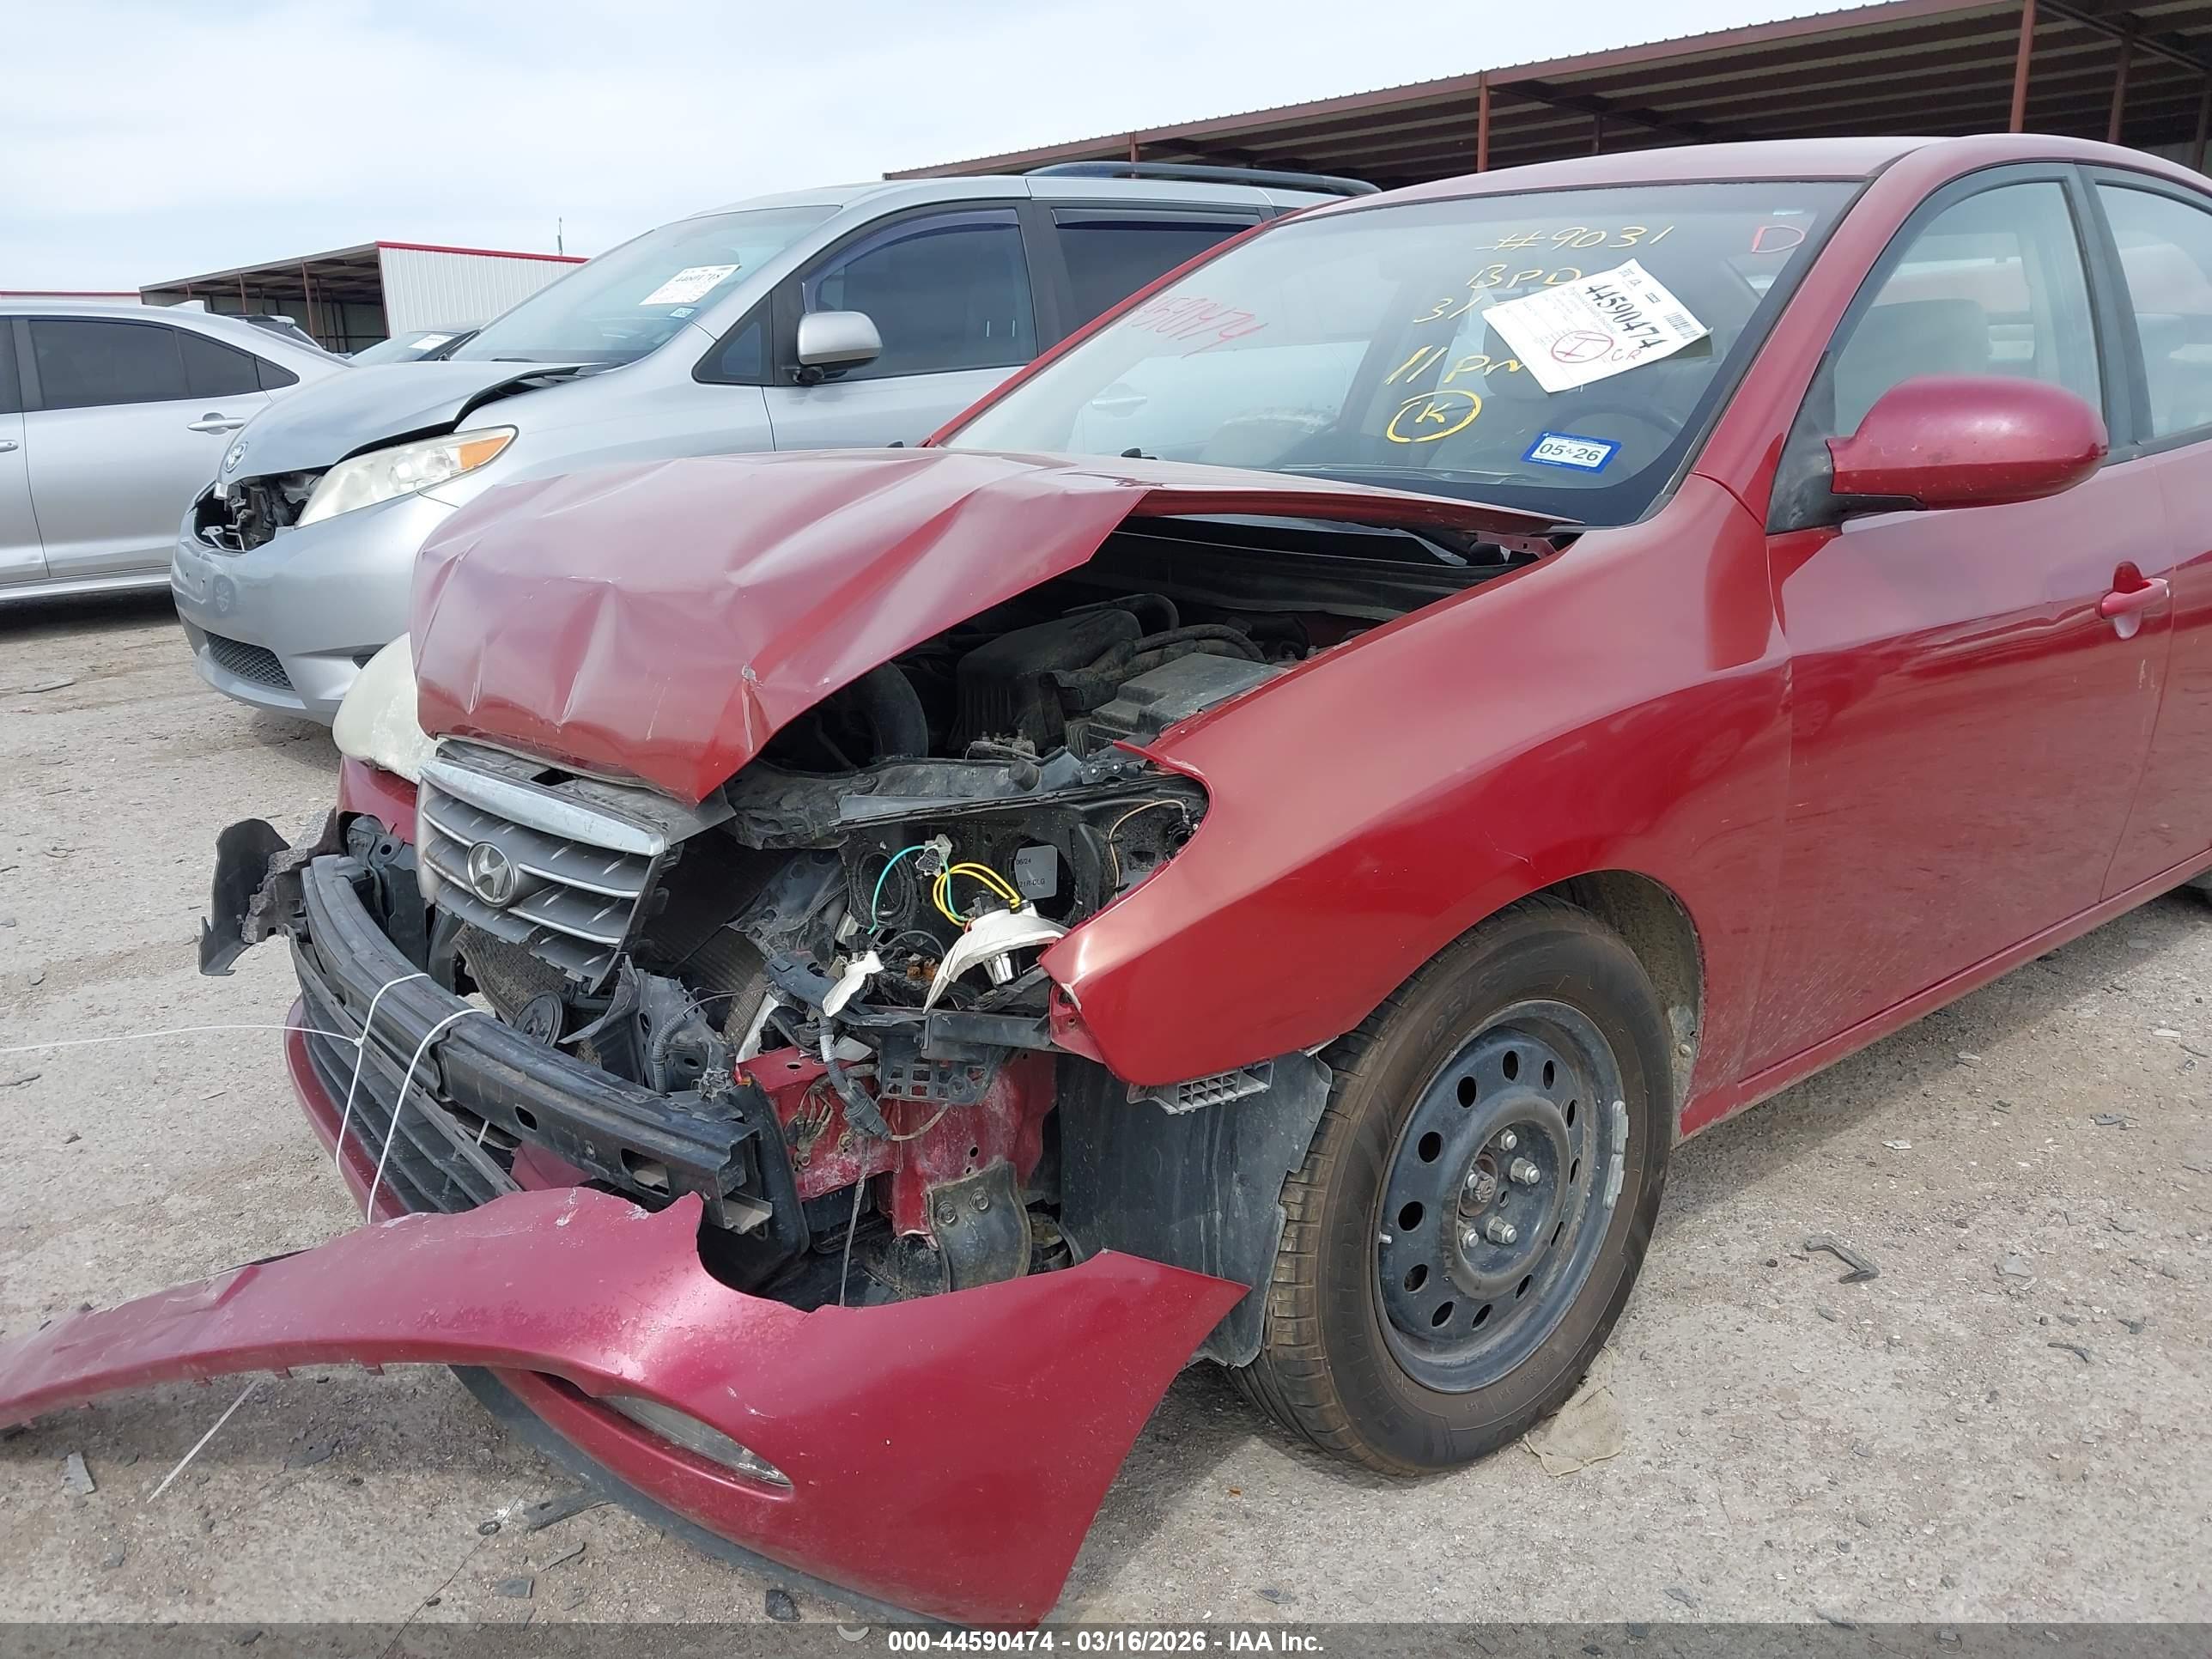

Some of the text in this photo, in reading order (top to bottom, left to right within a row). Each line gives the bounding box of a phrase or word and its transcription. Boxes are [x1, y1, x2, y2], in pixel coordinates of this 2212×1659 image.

[1475, 226, 1674, 252] #9031
[1752, 225, 1805, 252] D
[1467, 264, 1582, 289] BPD
[1585, 284, 1669, 349] 44590474
[1415, 401, 1454, 423] K
[1539, 443, 1567, 456] 05
[1572, 448, 1601, 461] 26
